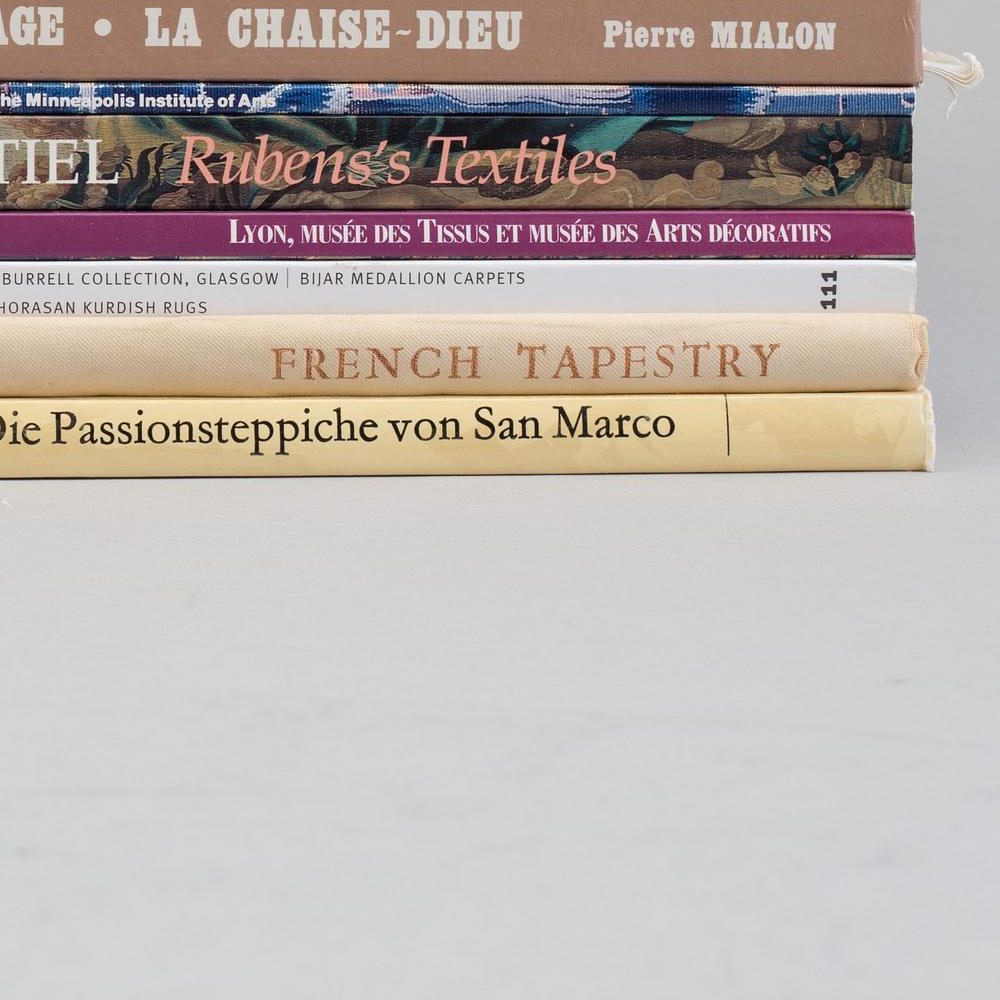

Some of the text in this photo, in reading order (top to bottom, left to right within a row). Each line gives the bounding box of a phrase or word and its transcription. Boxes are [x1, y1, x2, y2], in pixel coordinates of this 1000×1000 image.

[145, 7, 201, 48] LA
[603, 15, 836, 51] Pierre MIALON
[25, 92, 135, 112] Minneapolis
[139, 92, 214, 107] Institute
[217, 92, 235, 107] of
[238, 92, 277, 107] Arts
[427, 136, 618, 186] Textiles
[299, 217, 367, 244] MUSÉE
[373, 222, 410, 244] DES
[496, 222, 522, 244] ET
[528, 217, 596, 244] MUSÉE
[601, 222, 638, 244] DES
[708, 217, 832, 244] DÉCORATIFS
[2, 272, 74, 286] BURRELL
[81, 272, 190, 289] COLLECTION,
[196, 272, 278, 286] GLASGOW
[299, 272, 344, 288] BIJAR
[351, 272, 446, 285] MEDALLION
[453, 272, 525, 285] CARPETS
[819, 270, 838, 310] 111
[82, 301, 156, 315] KURDISH
[163, 301, 208, 315] RUGS
[271, 342, 781, 381] FRENCH TAPESTRY
[50, 408, 378, 457] Passionsteppiche
[389, 416, 460, 443] von
[473, 407, 542, 443] San
[553, 404, 676, 440] Marco
